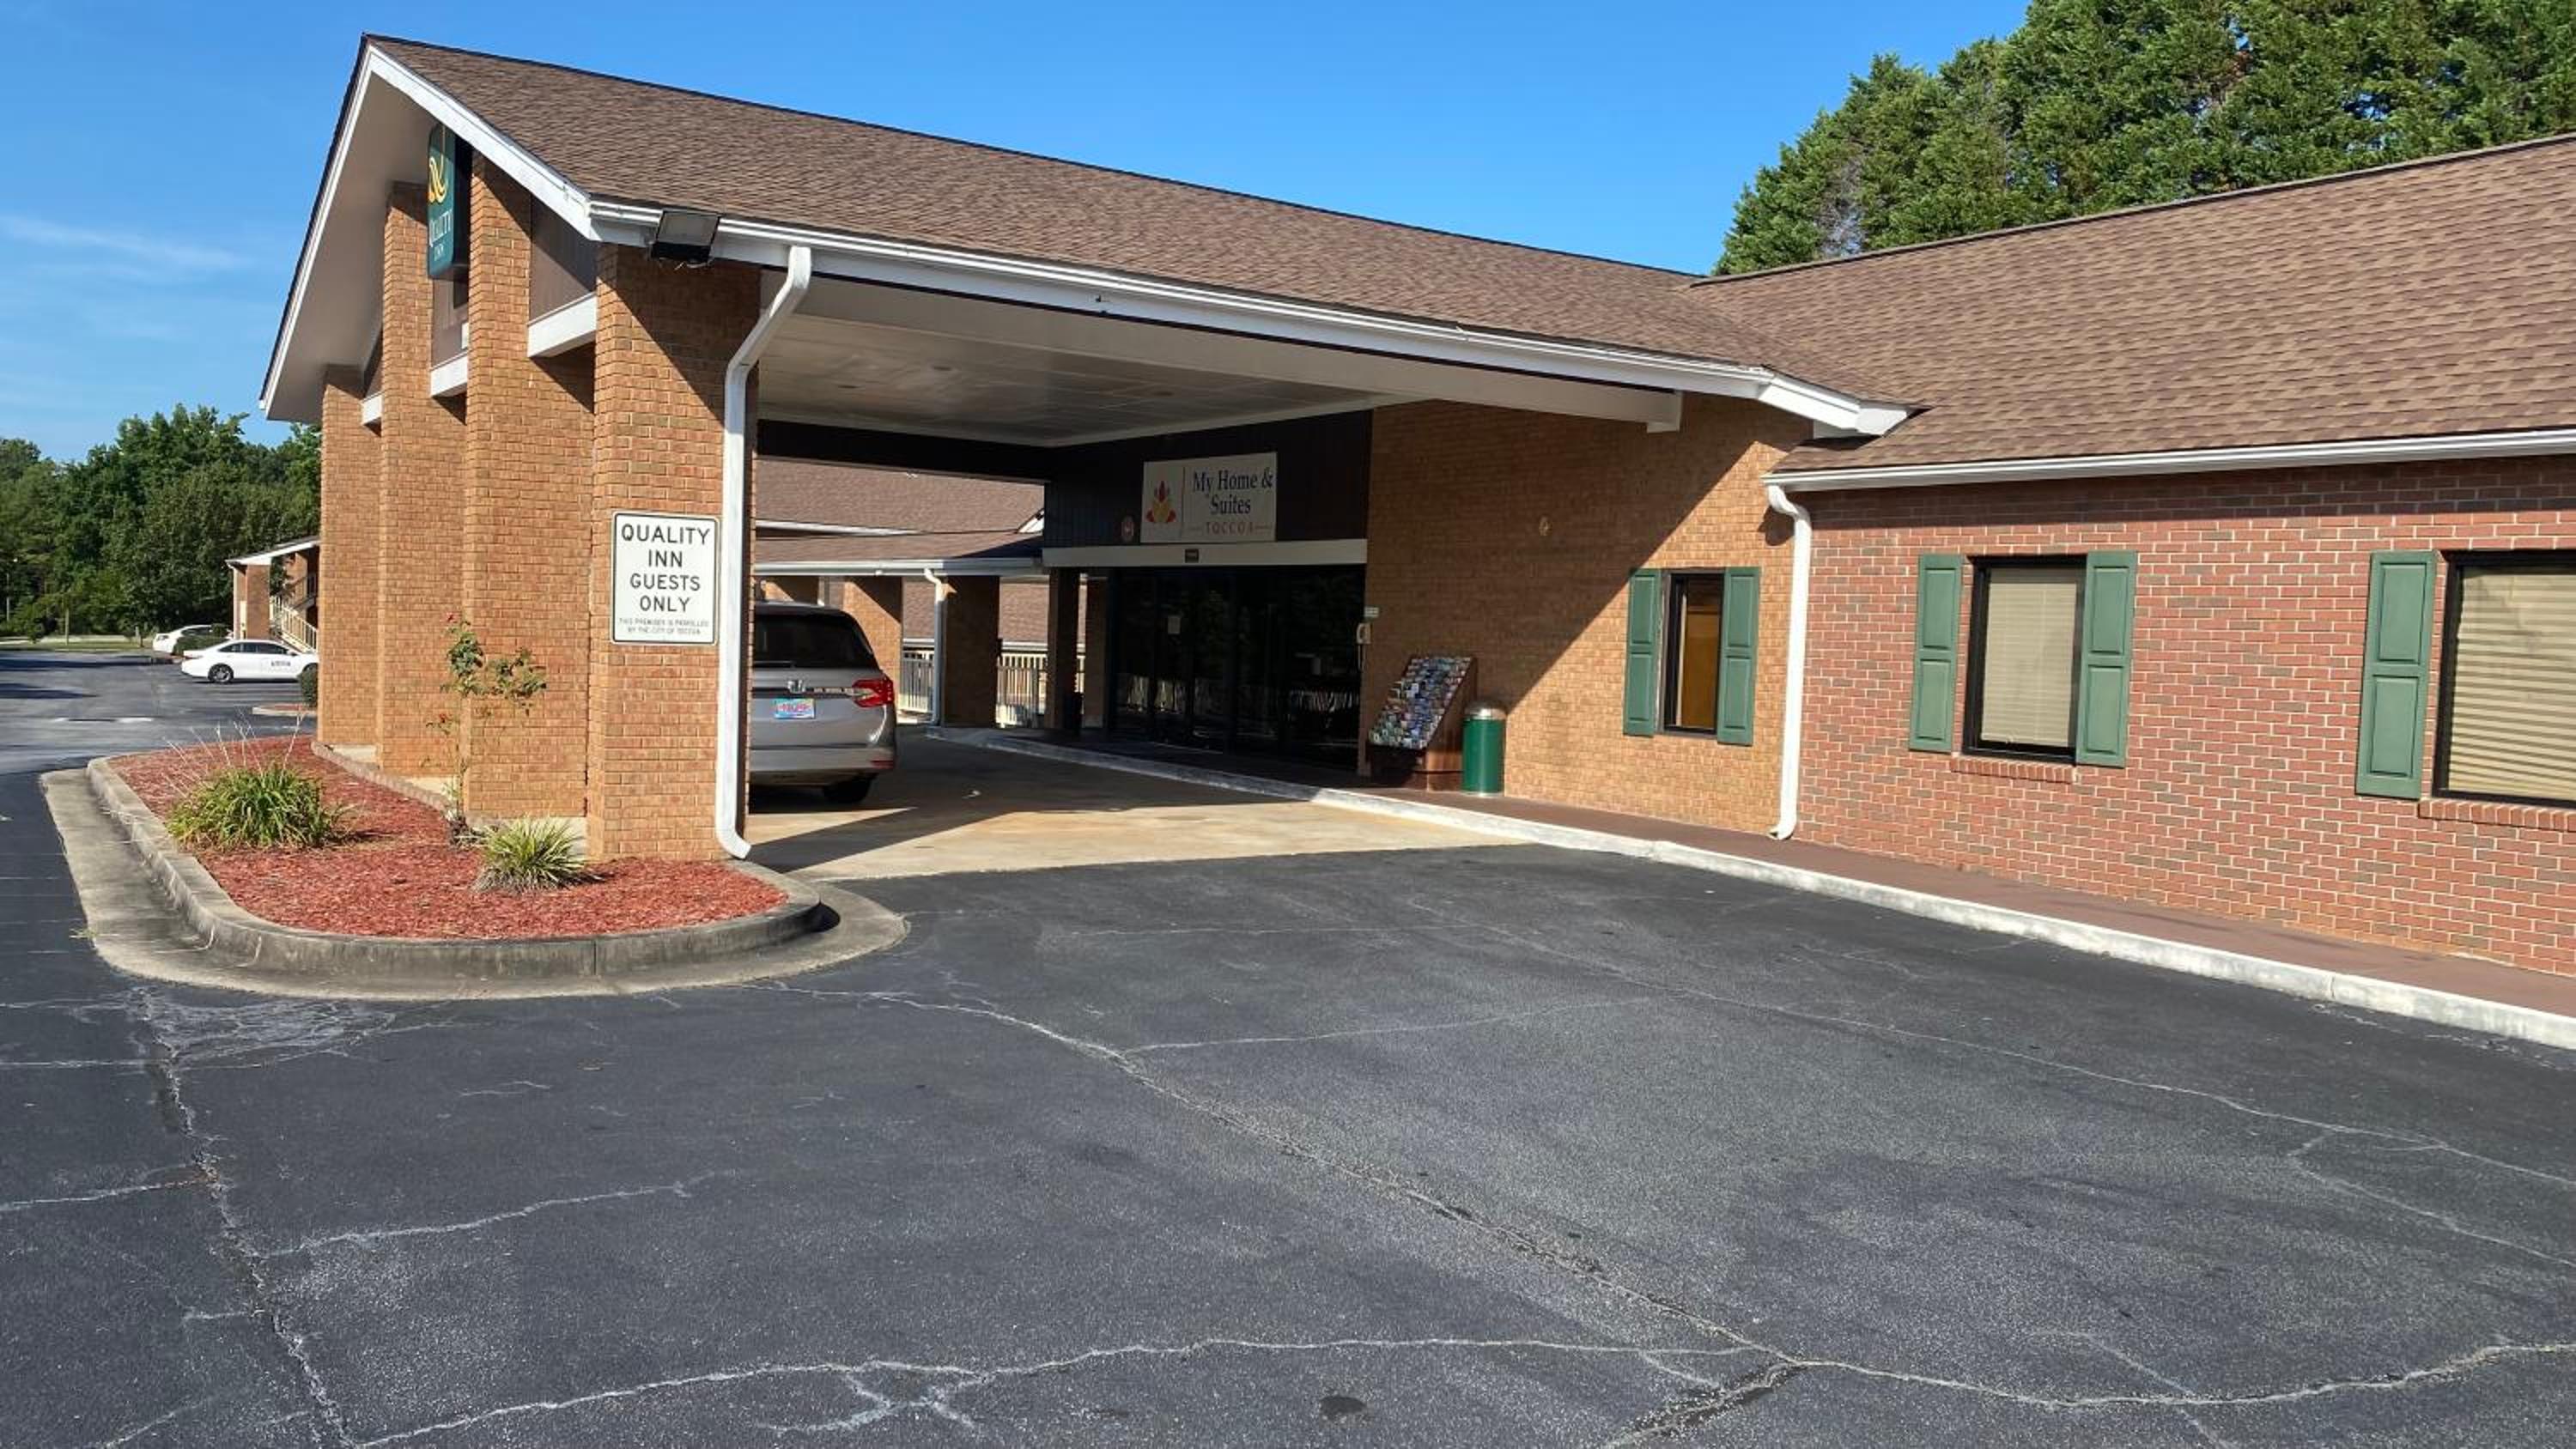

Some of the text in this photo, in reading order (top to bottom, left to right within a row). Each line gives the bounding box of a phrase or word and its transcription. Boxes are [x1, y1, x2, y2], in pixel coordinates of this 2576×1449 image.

[1193, 466, 1274, 498] My Home &
[1210, 494, 1252, 515] Suites
[621, 523, 711, 545] QUALITY
[648, 549, 683, 568] INN
[629, 573, 701, 591] GUESTS
[640, 595, 690, 613] ONLY
